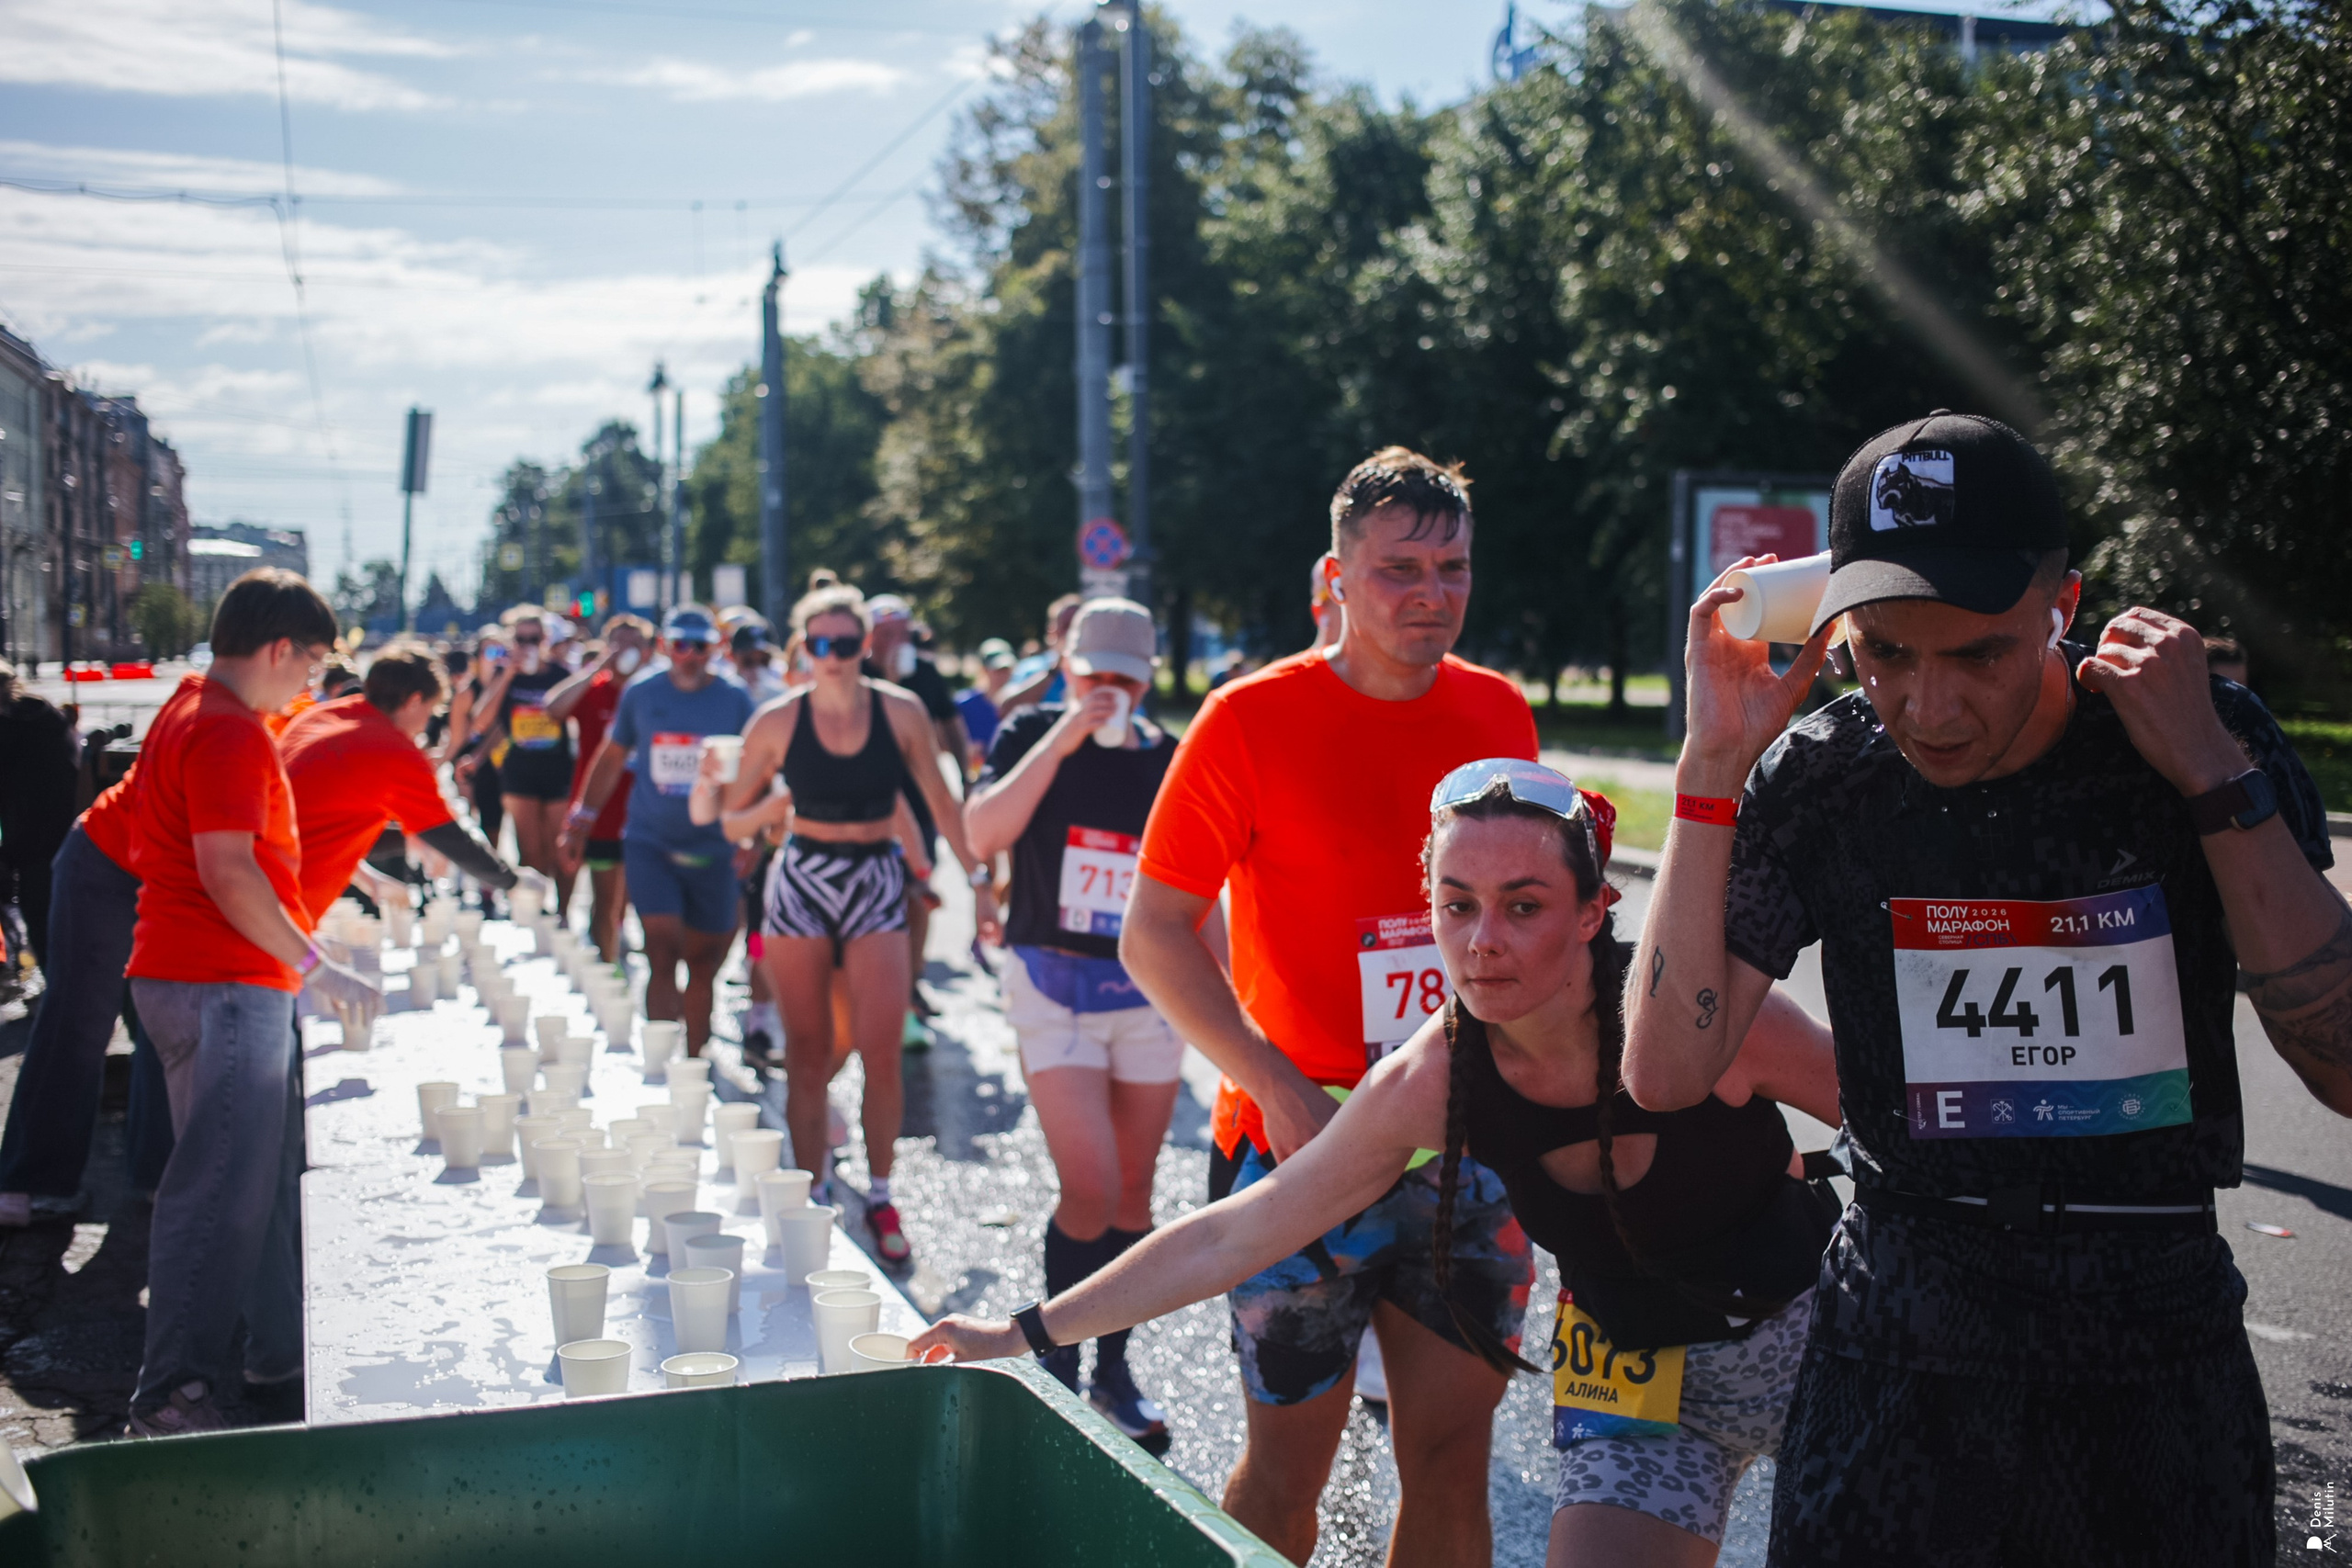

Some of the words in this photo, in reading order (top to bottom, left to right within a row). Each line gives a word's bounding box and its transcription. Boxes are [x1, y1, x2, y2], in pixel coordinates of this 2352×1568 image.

[1902, 450, 1950, 462] PITTBULL
[2097, 871, 2156, 889] DEMIX
[1927, 906, 1968, 919] ПОЛУ
[2051, 915, 2089, 934] 21,1
[2098, 908, 2135, 929] КМ
[1928, 919, 2010, 932] МАРАФОН
[1936, 964, 2135, 1037] 4411
[2011, 1046, 2076, 1066] ЕГОР
[1937, 1090, 1965, 1128] E
[1565, 1382, 1619, 1404] АЛИНА
